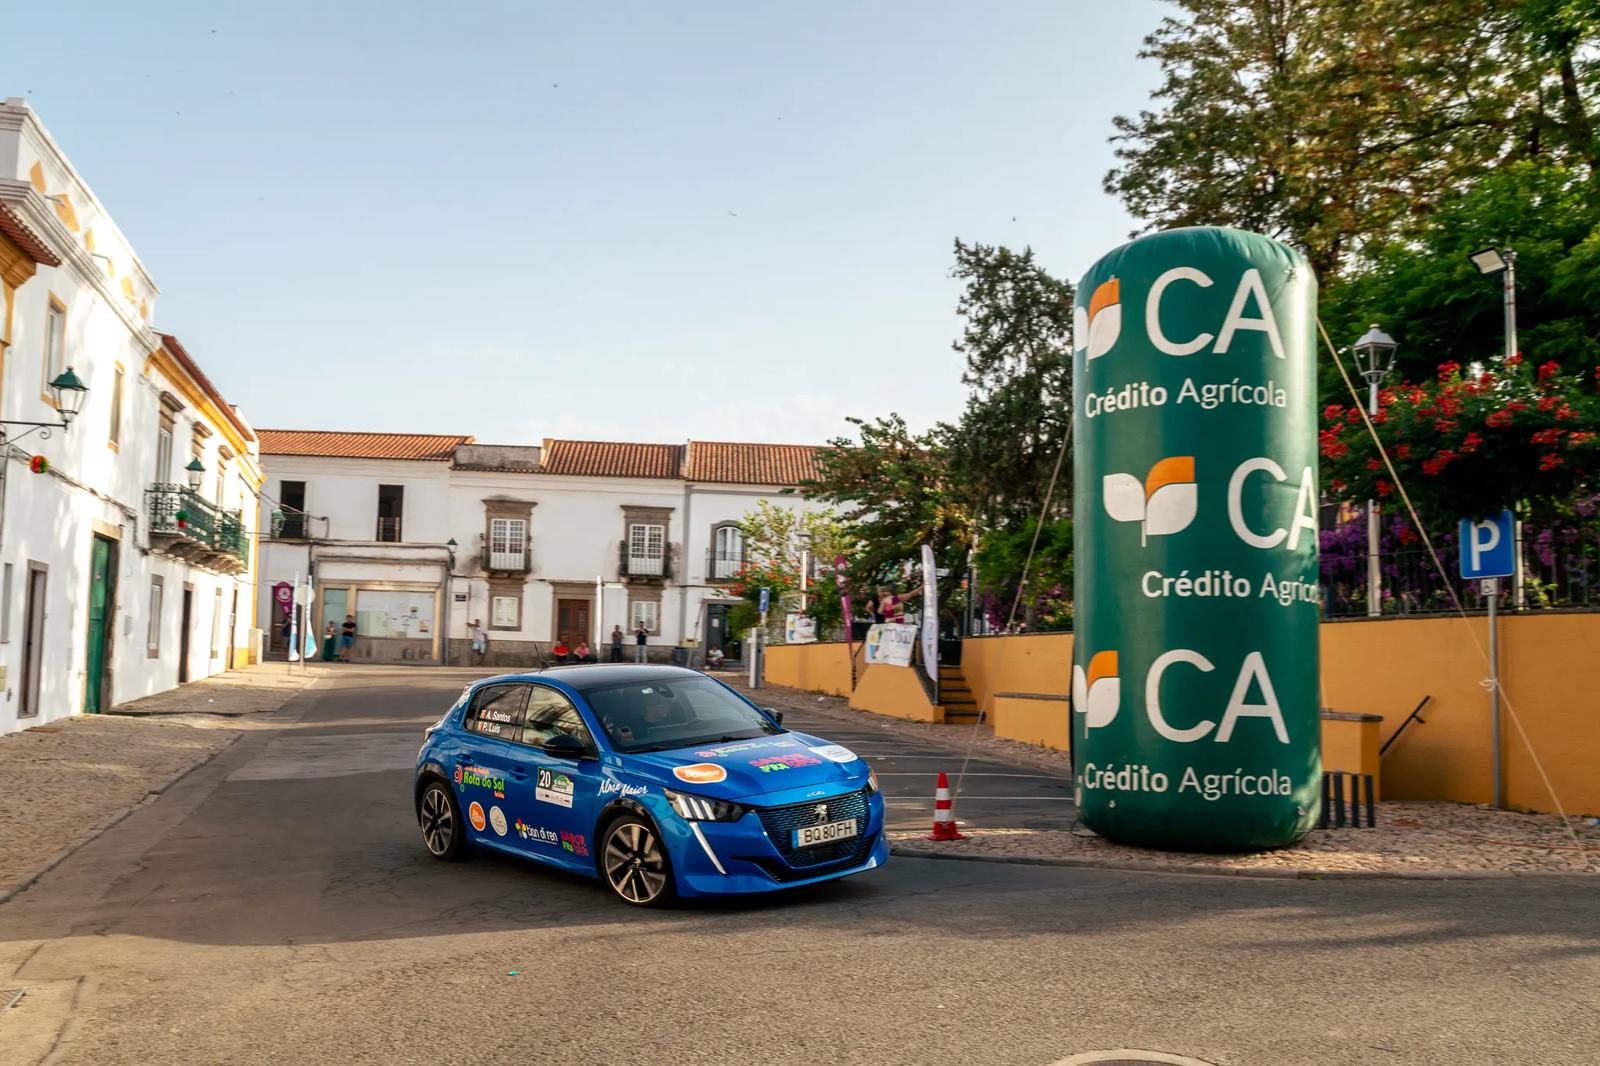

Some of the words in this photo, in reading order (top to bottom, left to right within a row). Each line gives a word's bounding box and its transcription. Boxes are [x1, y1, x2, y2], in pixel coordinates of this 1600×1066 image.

[1145, 266, 1286, 360] CA
[1084, 381, 1168, 419] Crédito
[1176, 377, 1287, 410] Agrícola
[1227, 456, 1319, 551] CA
[1470, 519, 1501, 571] P
[1141, 570, 1251, 598] Crédito
[1145, 648, 1291, 744] CA
[482, 722, 488, 732] P.
[485, 710, 492, 721] A.
[493, 711, 512, 723] Santos
[463, 771, 481, 786] Rota
[481, 775, 492, 789] do
[493, 776, 505, 791] Sol
[538, 769, 551, 788] 20
[1084, 763, 1169, 793] Crédito
[1178, 766, 1292, 801] Agrícola
[804, 828, 821, 843] BQ
[822, 825, 834, 839] 80
[837, 821, 852, 836] FH
